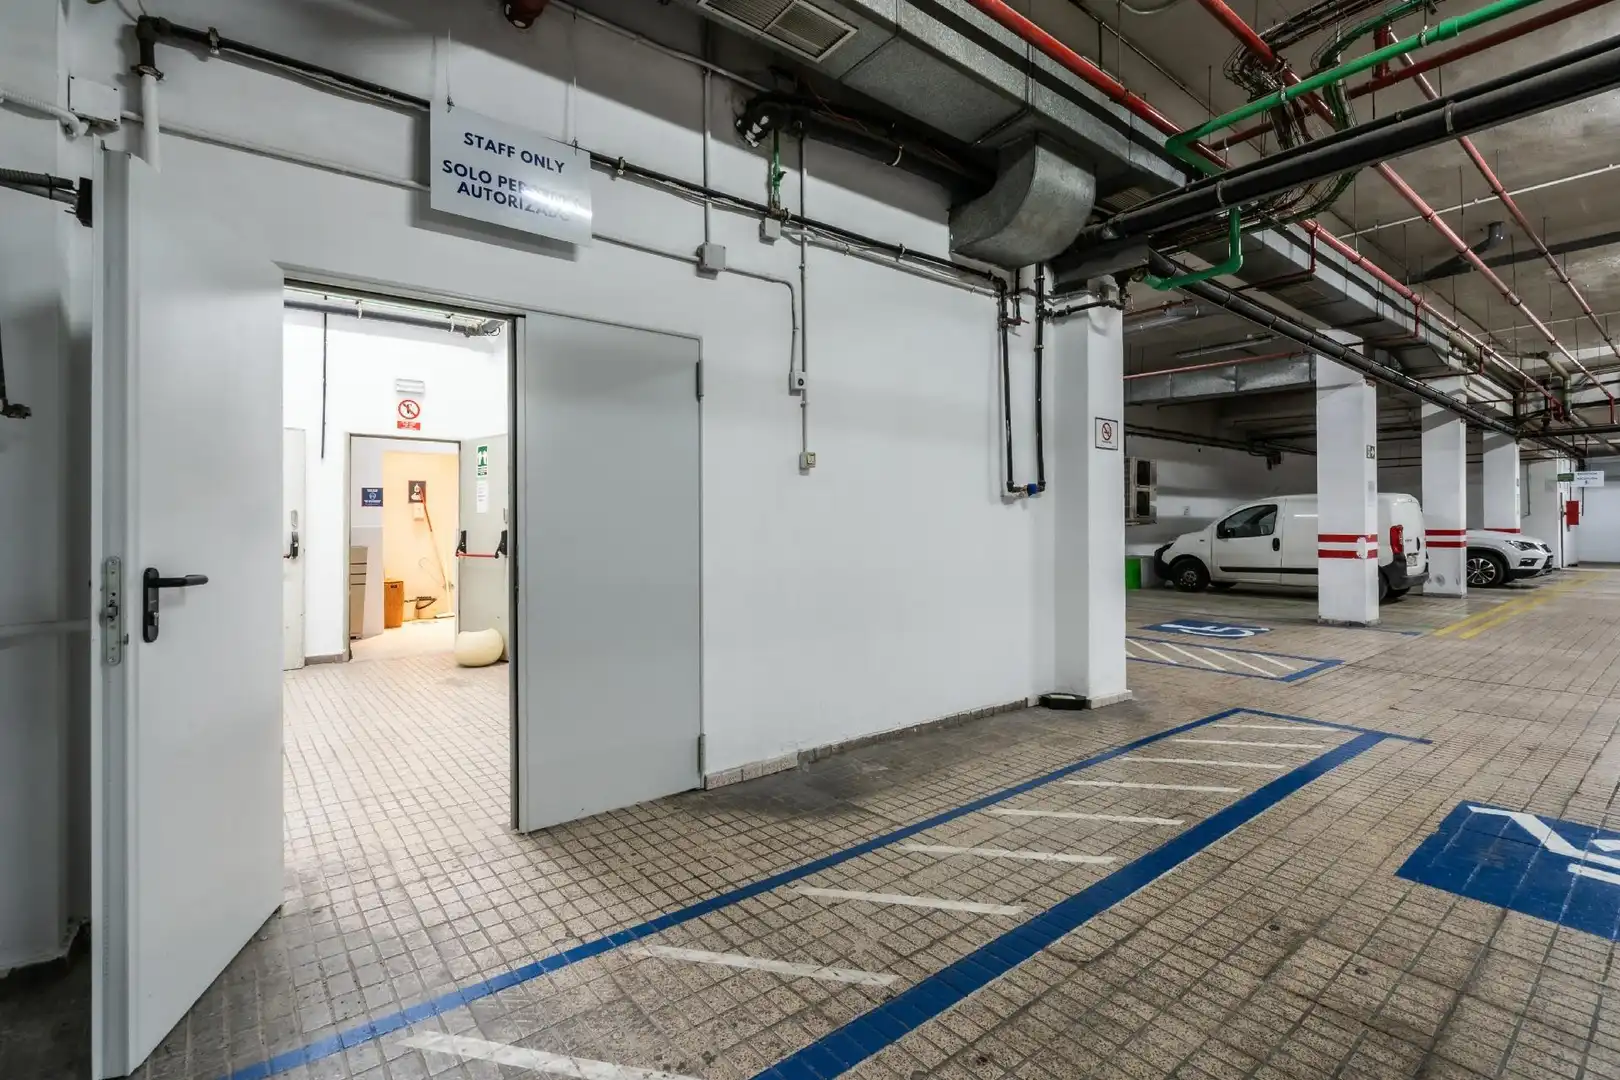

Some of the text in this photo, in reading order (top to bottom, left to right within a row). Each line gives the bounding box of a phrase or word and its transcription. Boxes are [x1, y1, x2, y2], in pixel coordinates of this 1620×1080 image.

[464, 132, 565, 174] STAFF ONLY
[442, 160, 492, 184] SOLO
